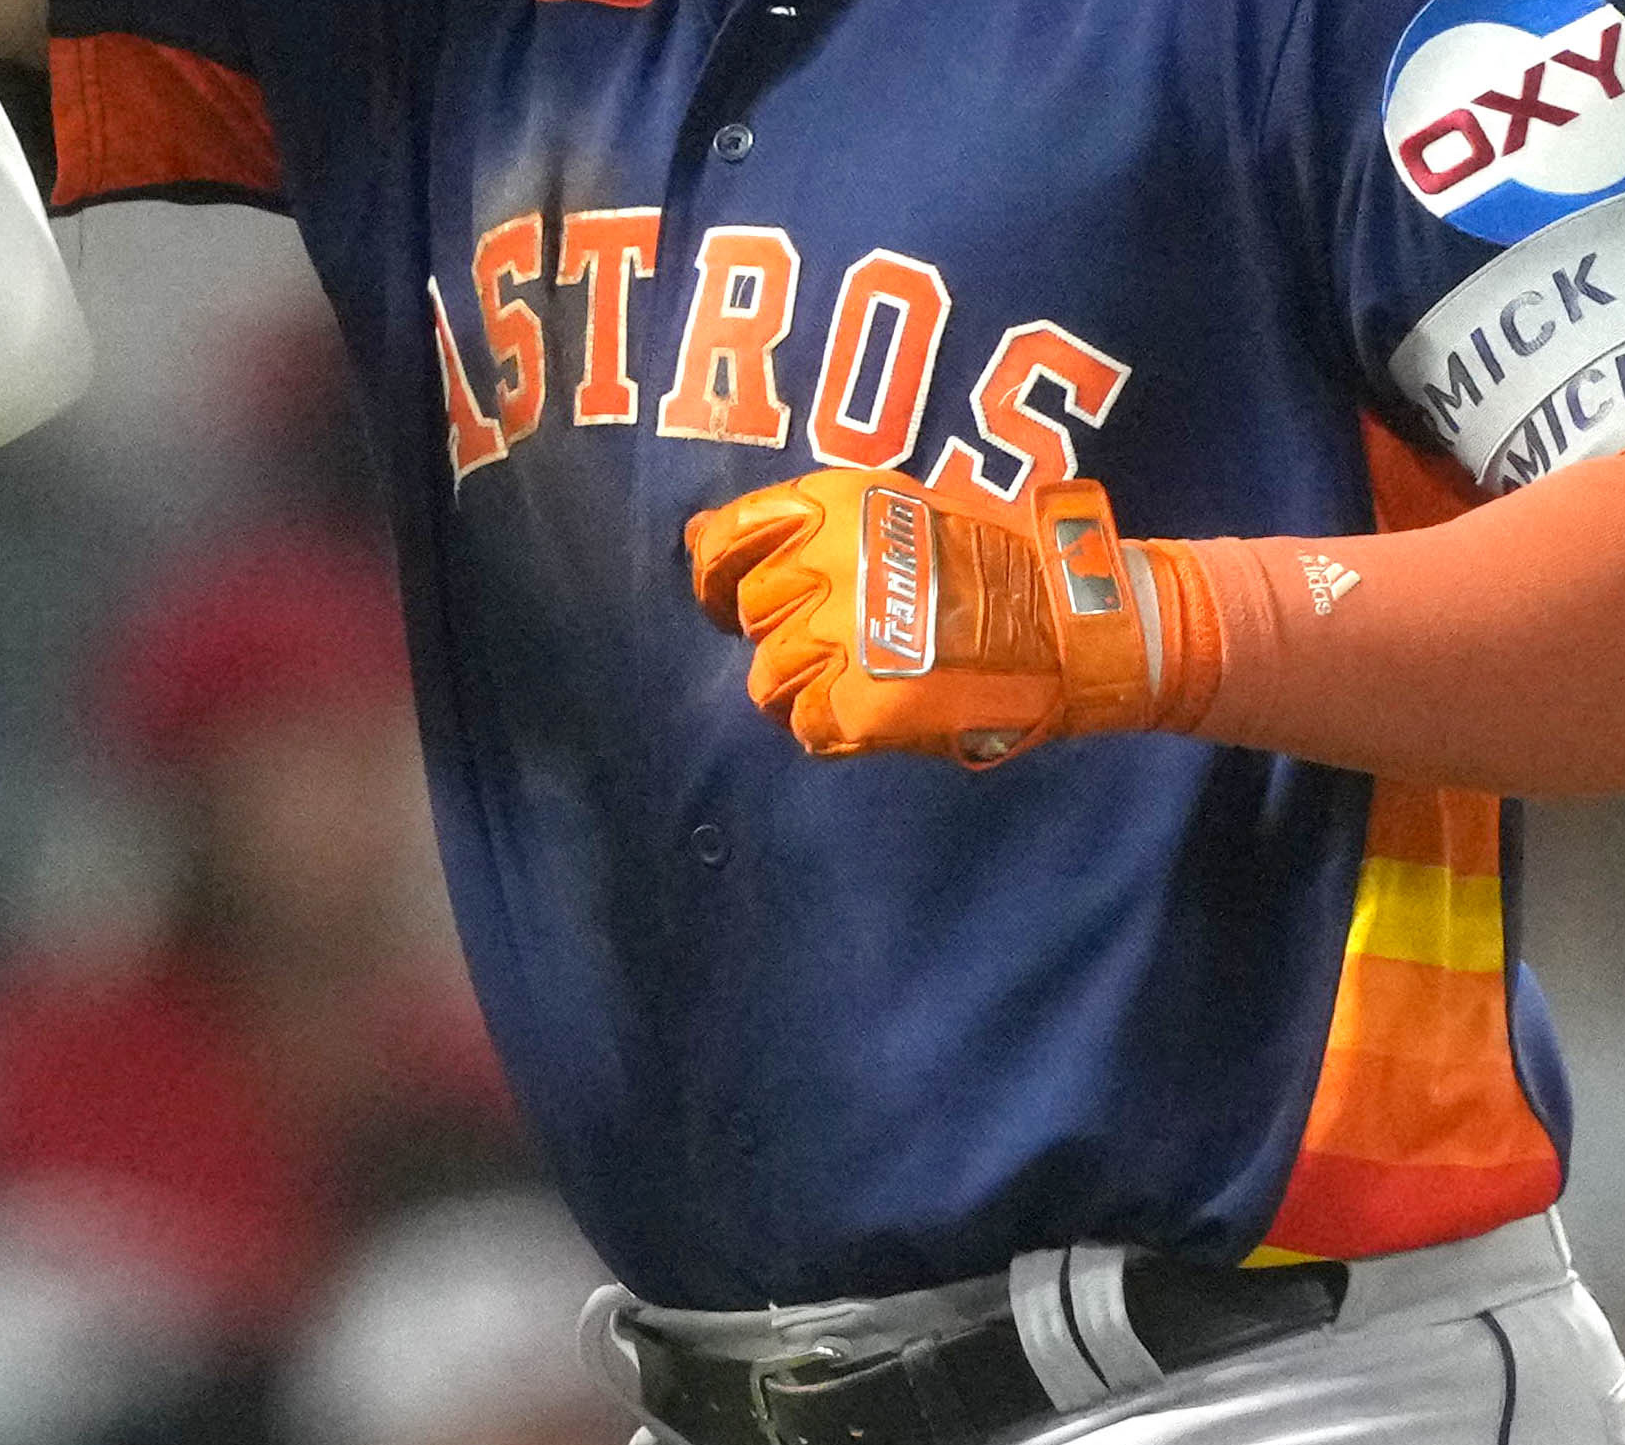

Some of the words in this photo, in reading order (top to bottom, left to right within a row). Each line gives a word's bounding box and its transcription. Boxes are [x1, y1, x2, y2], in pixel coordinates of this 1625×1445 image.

[1399, 22, 1625, 196] OXY
[1422, 252, 1617, 446] MICK
[869, 496, 924, 662] Franklin
